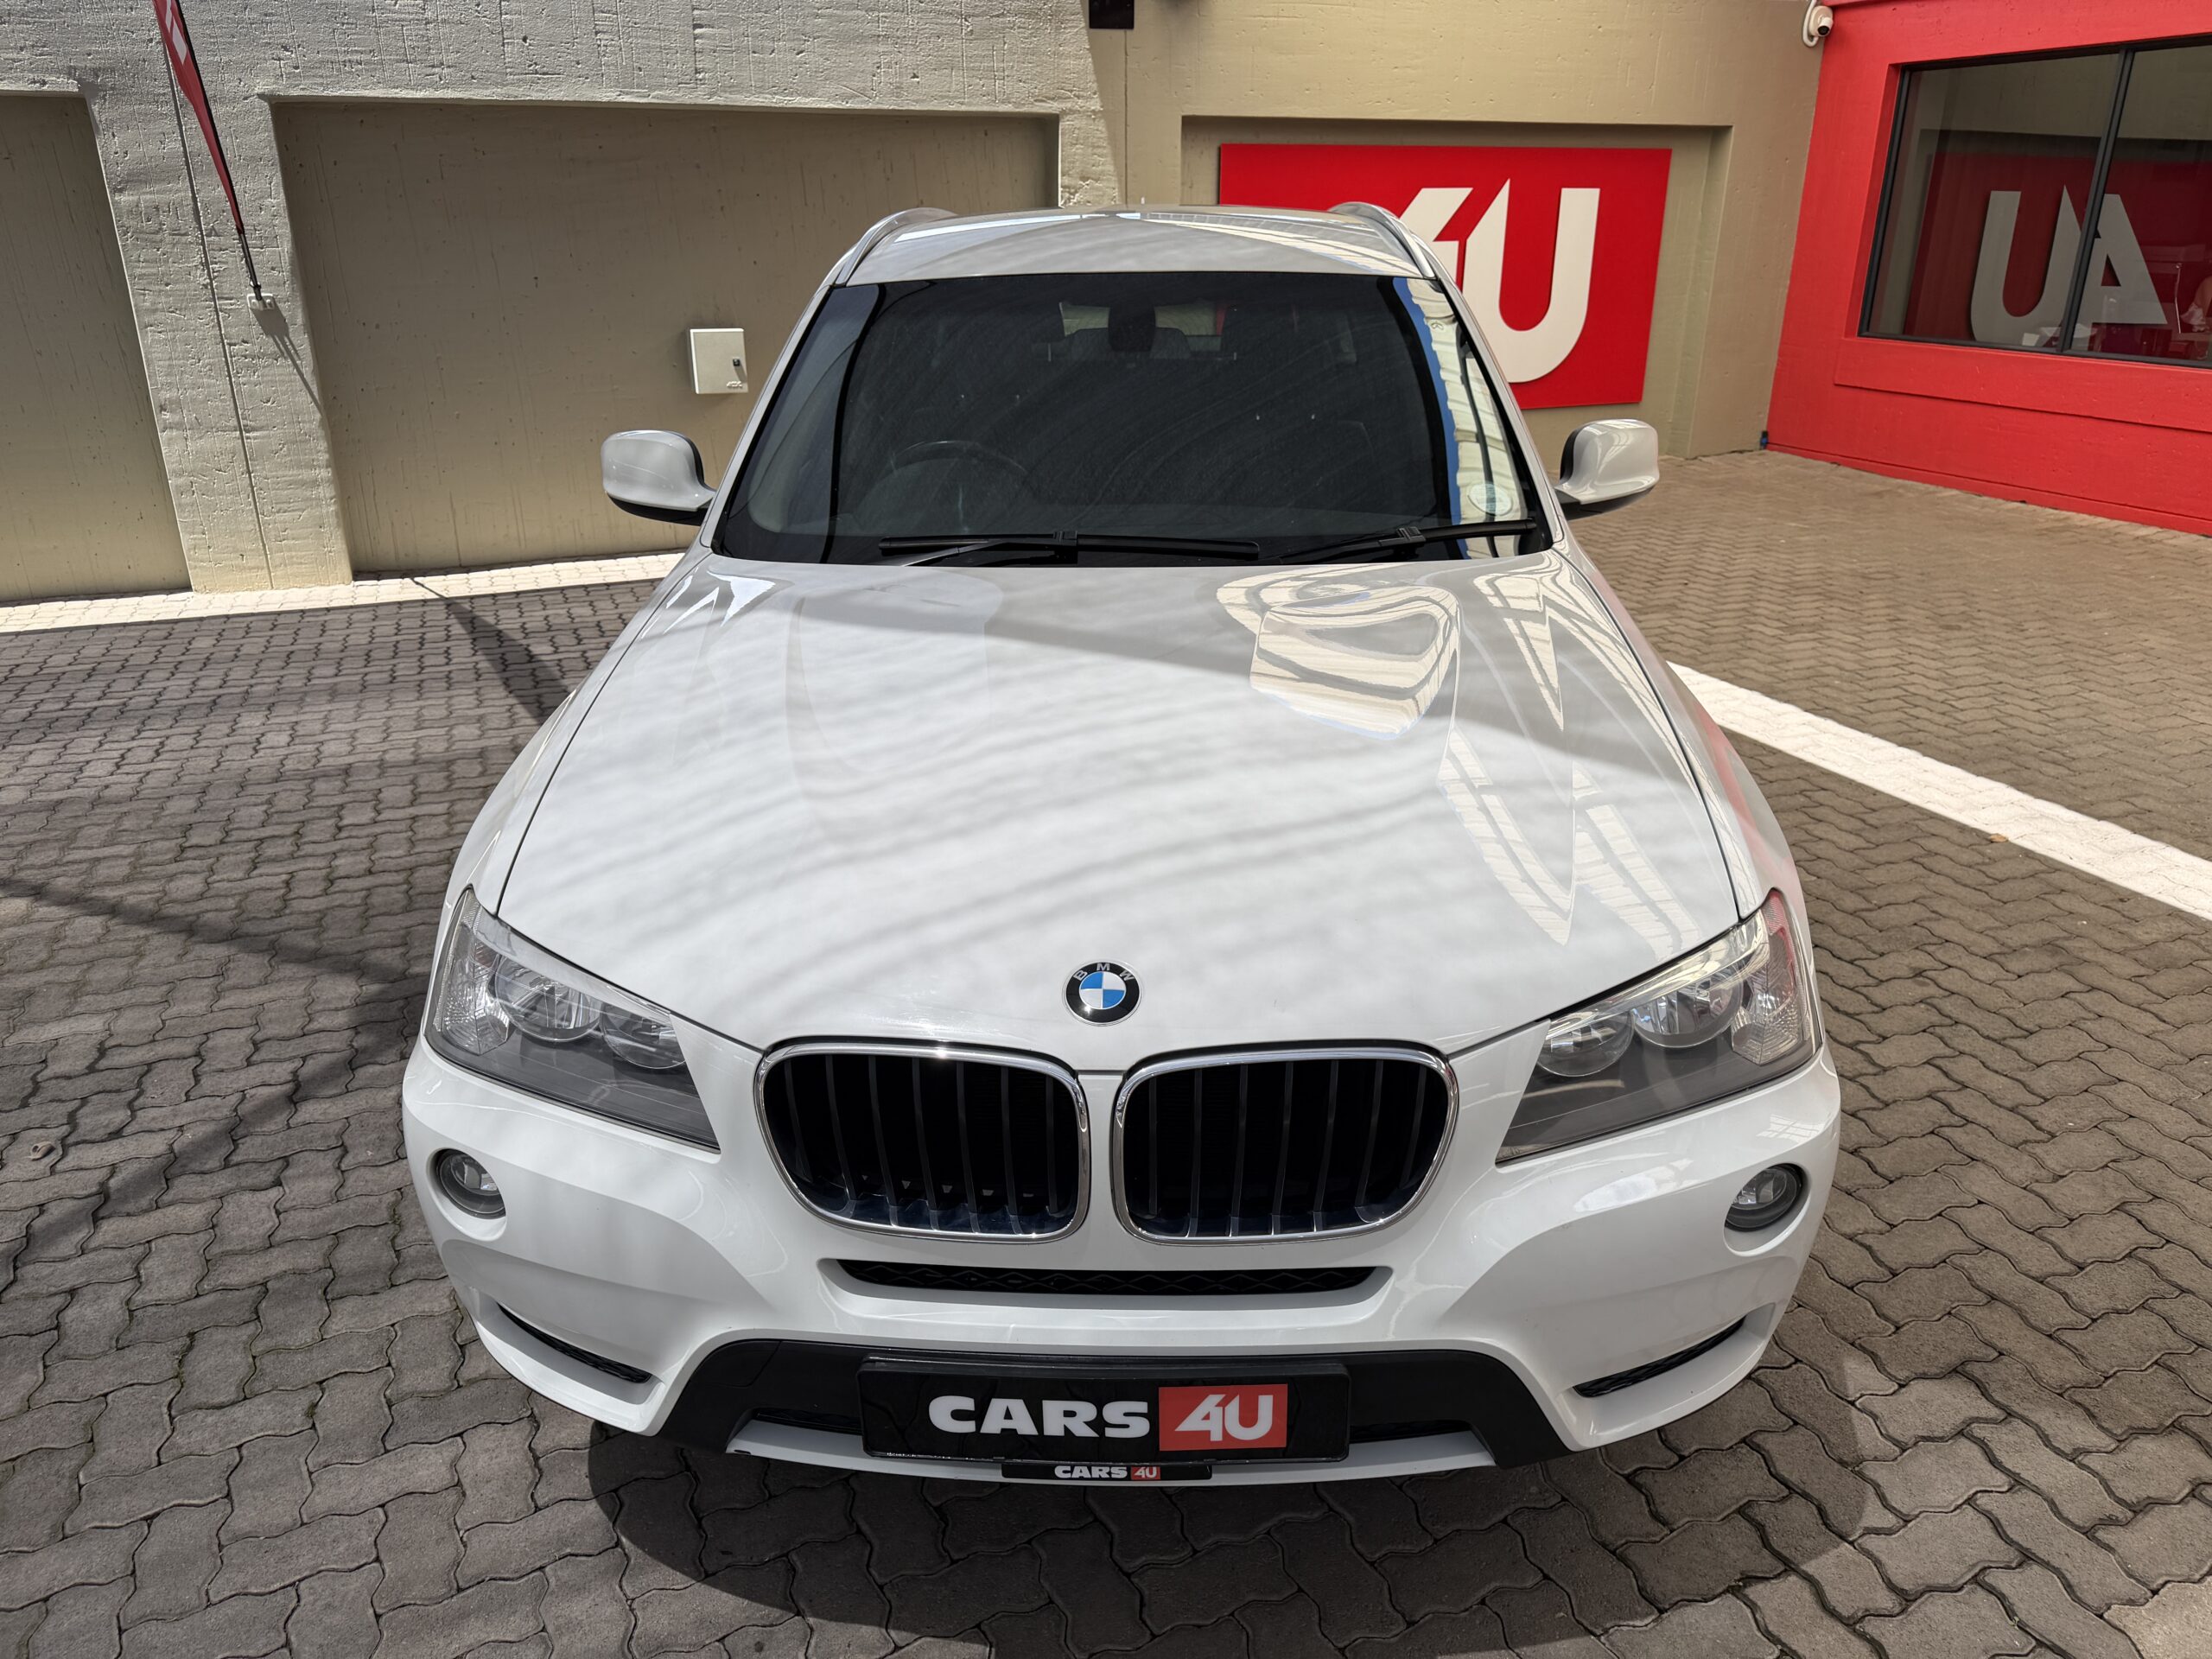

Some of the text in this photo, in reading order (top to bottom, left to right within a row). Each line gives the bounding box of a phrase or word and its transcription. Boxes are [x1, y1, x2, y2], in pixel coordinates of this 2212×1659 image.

[929, 1393, 1274, 1441] CARS 4U
[1054, 1465, 1157, 1478] CARS 4U
